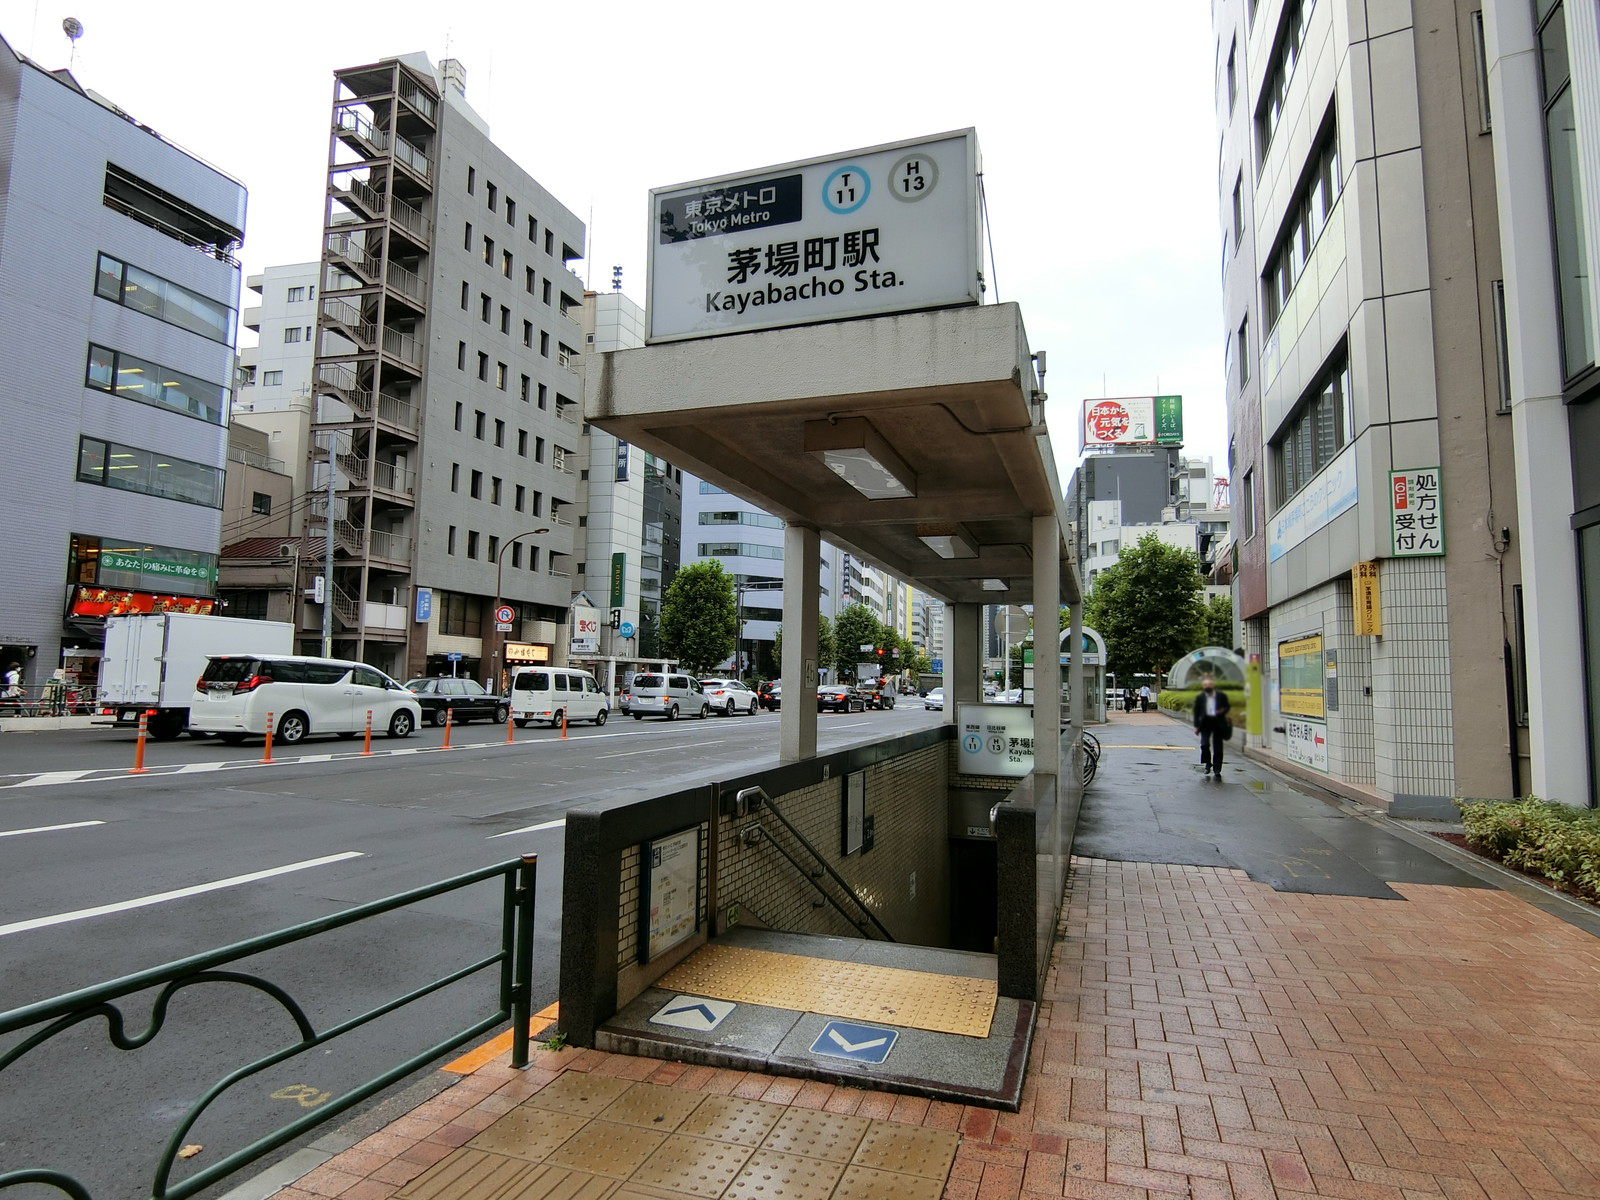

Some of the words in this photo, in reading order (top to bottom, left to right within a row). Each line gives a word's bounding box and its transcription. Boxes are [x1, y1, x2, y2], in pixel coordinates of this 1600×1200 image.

[906, 161, 920, 175] H
[841, 174, 851, 187] T
[902, 175, 925, 192] 13
[684, 186, 776, 219] 東京メトロ
[836, 188, 856, 204] 11
[689, 216, 728, 234] Tokyo
[730, 209, 771, 226] Metro
[727, 228, 881, 284] 茅場町駅
[706, 276, 845, 315] Kayabacho
[854, 269, 905, 292] Sta.
[1091, 405, 1128, 417] 日本から
[1100, 416, 1130, 428] 元気を
[1097, 428, 1123, 439] つくる
[1395, 482, 1406, 504] 6F
[1415, 474, 1439, 550] 処方せん
[1395, 513, 1416, 550] 受付
[1359, 565, 1368, 578] 内科
[1368, 564, 1377, 578] 外科
[1008, 737, 1034, 749] 茅場
